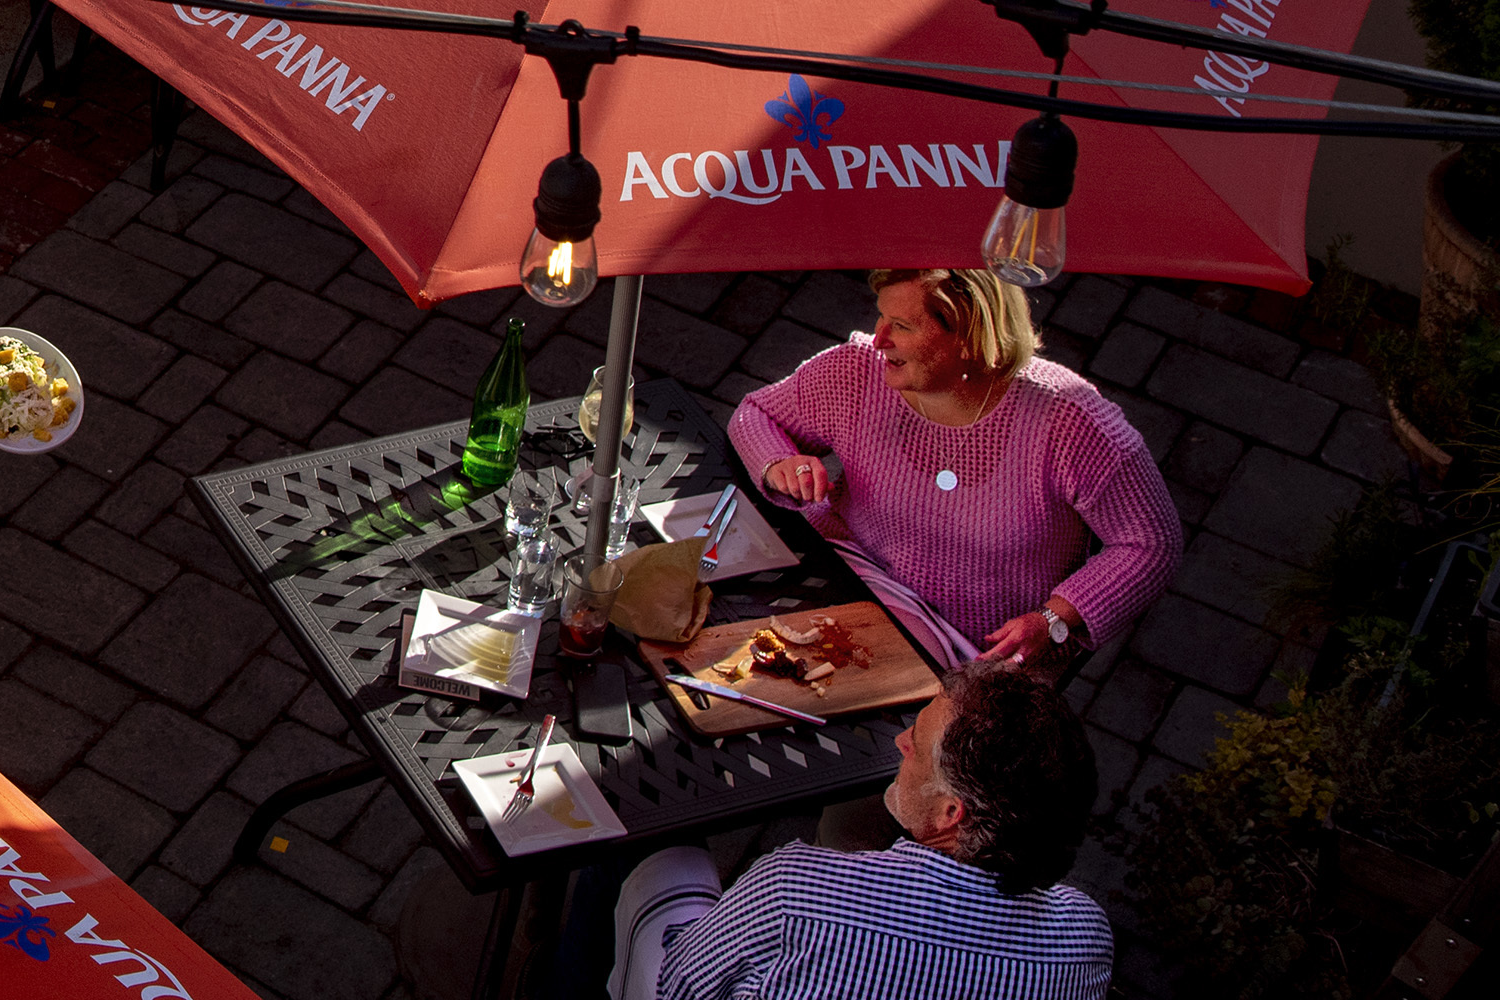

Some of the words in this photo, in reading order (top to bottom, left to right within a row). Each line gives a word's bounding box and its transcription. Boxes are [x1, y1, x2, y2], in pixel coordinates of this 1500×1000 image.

[620, 147, 826, 205] ACQUA
[827, 140, 1011, 189] PANN
[412, 674, 471, 697] WELCOME
